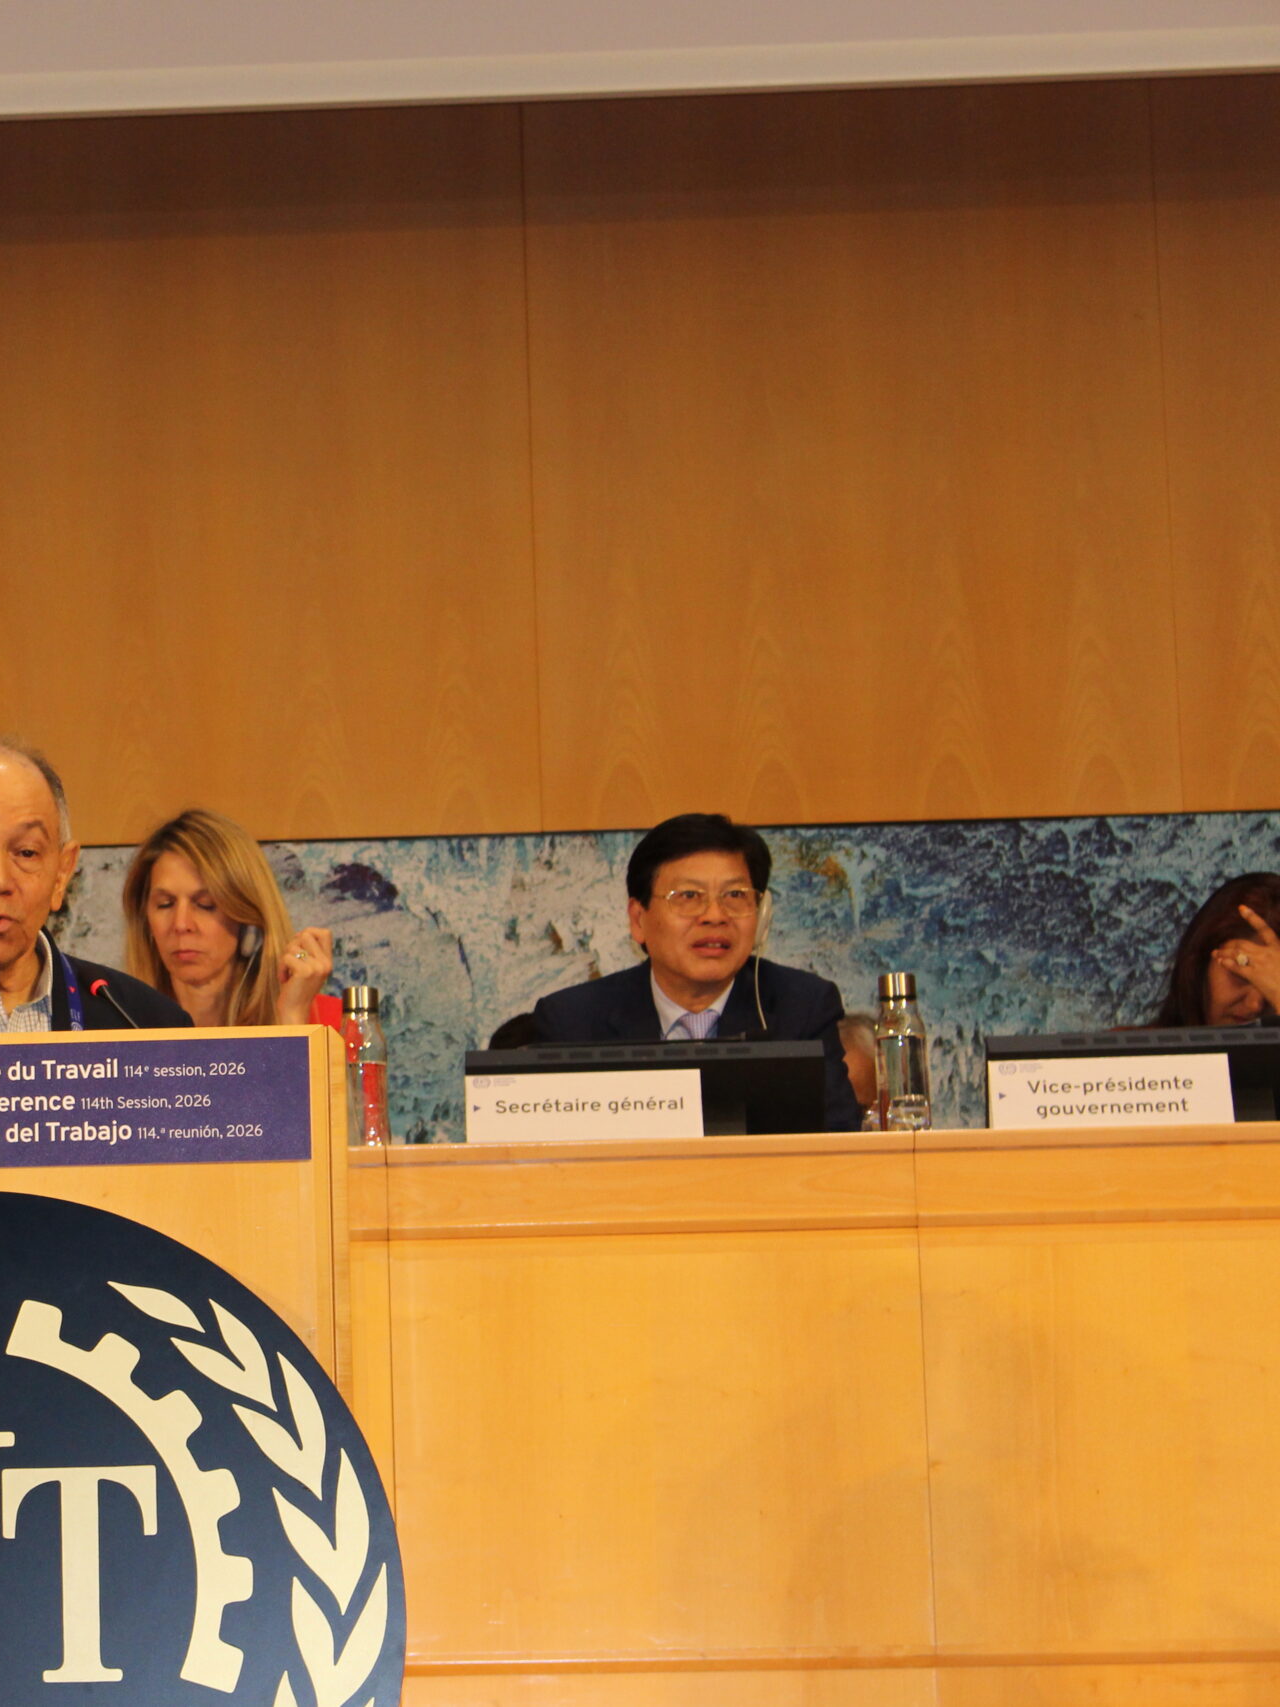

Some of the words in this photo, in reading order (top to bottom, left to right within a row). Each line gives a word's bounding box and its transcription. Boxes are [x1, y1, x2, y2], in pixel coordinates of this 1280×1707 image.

[7, 1060, 36, 1081] du
[40, 1057, 119, 1080] Travail
[153, 1064, 206, 1078] session,
[209, 1062, 246, 1076] 2026
[1027, 1076, 1193, 1095] Vice-présidente
[80, 1096, 114, 1110] 114th
[117, 1095, 172, 1110] Session,
[174, 1093, 212, 1108] 2026
[495, 1098, 601, 1114] Secrétaire
[608, 1096, 685, 1114] général
[1036, 1098, 1189, 1119] gouvernement
[5, 1121, 40, 1144] del
[45, 1120, 133, 1146] Trabajo
[168, 1124, 224, 1140] reunión,
[226, 1123, 264, 1138] 2026
